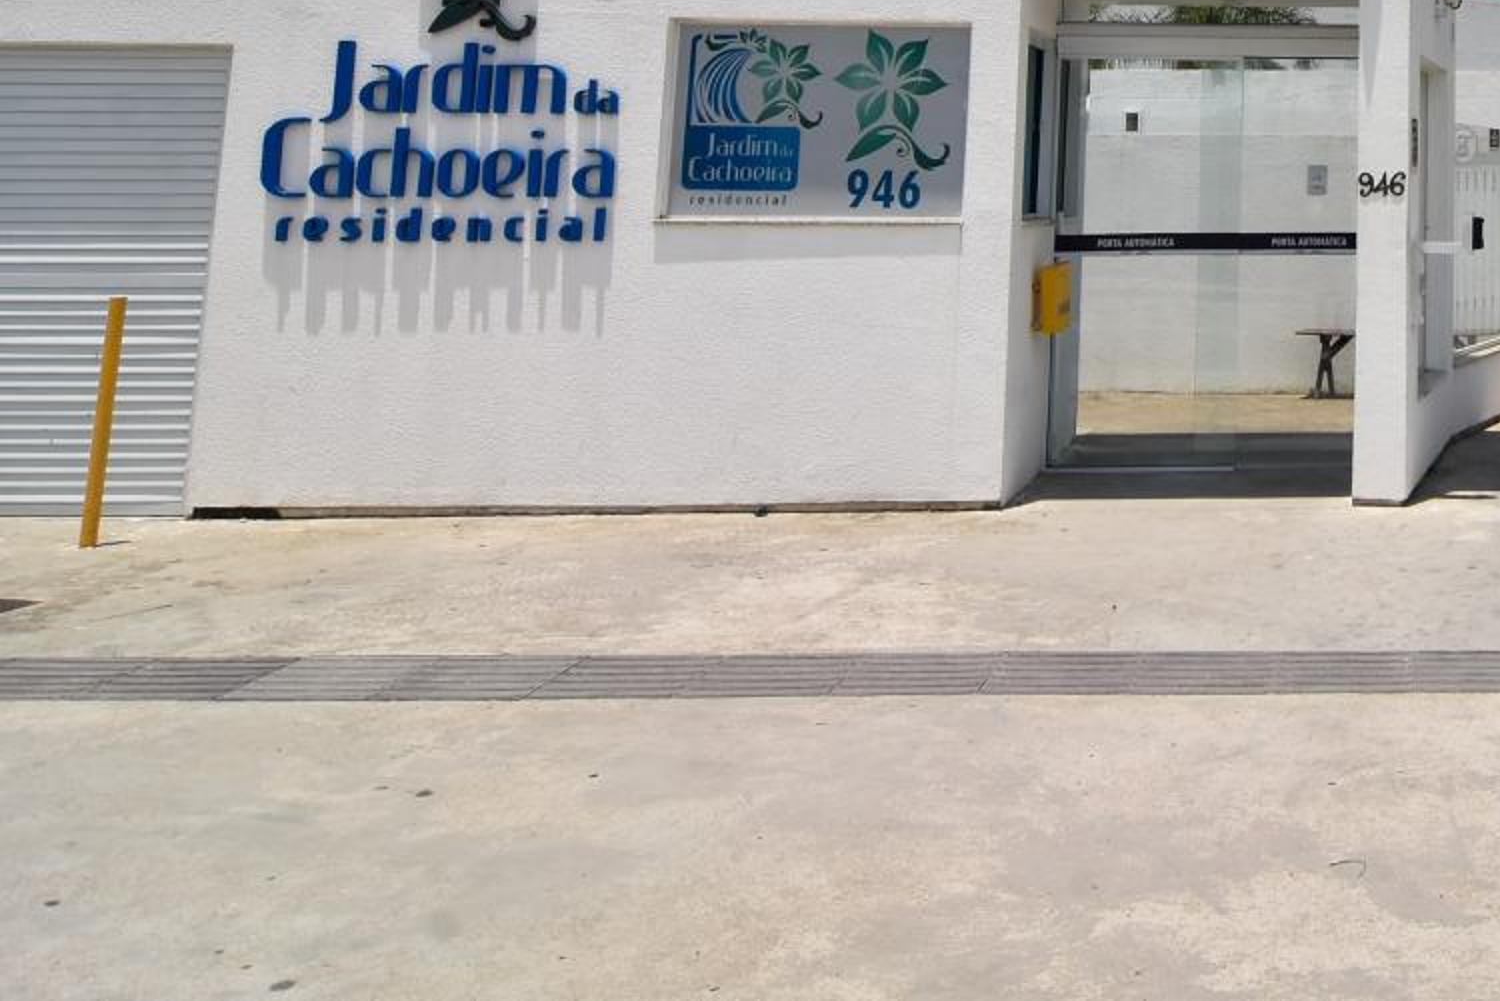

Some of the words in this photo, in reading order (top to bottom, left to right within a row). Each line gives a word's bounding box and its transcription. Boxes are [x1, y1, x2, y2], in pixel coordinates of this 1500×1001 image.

[320, 40, 567, 123] Jardim
[573, 79, 619, 115] da
[706, 132, 779, 157] Jardim
[260, 117, 615, 199] Cachoeira
[687, 158, 792, 183] Cachoeira
[847, 168, 921, 209] 946
[1358, 171, 1406, 197] 946
[688, 194, 788, 206] residencial
[274, 207, 607, 242] residencial
[1097, 237, 1122, 248] PORTA
[1271, 236, 1296, 248] PORTA
